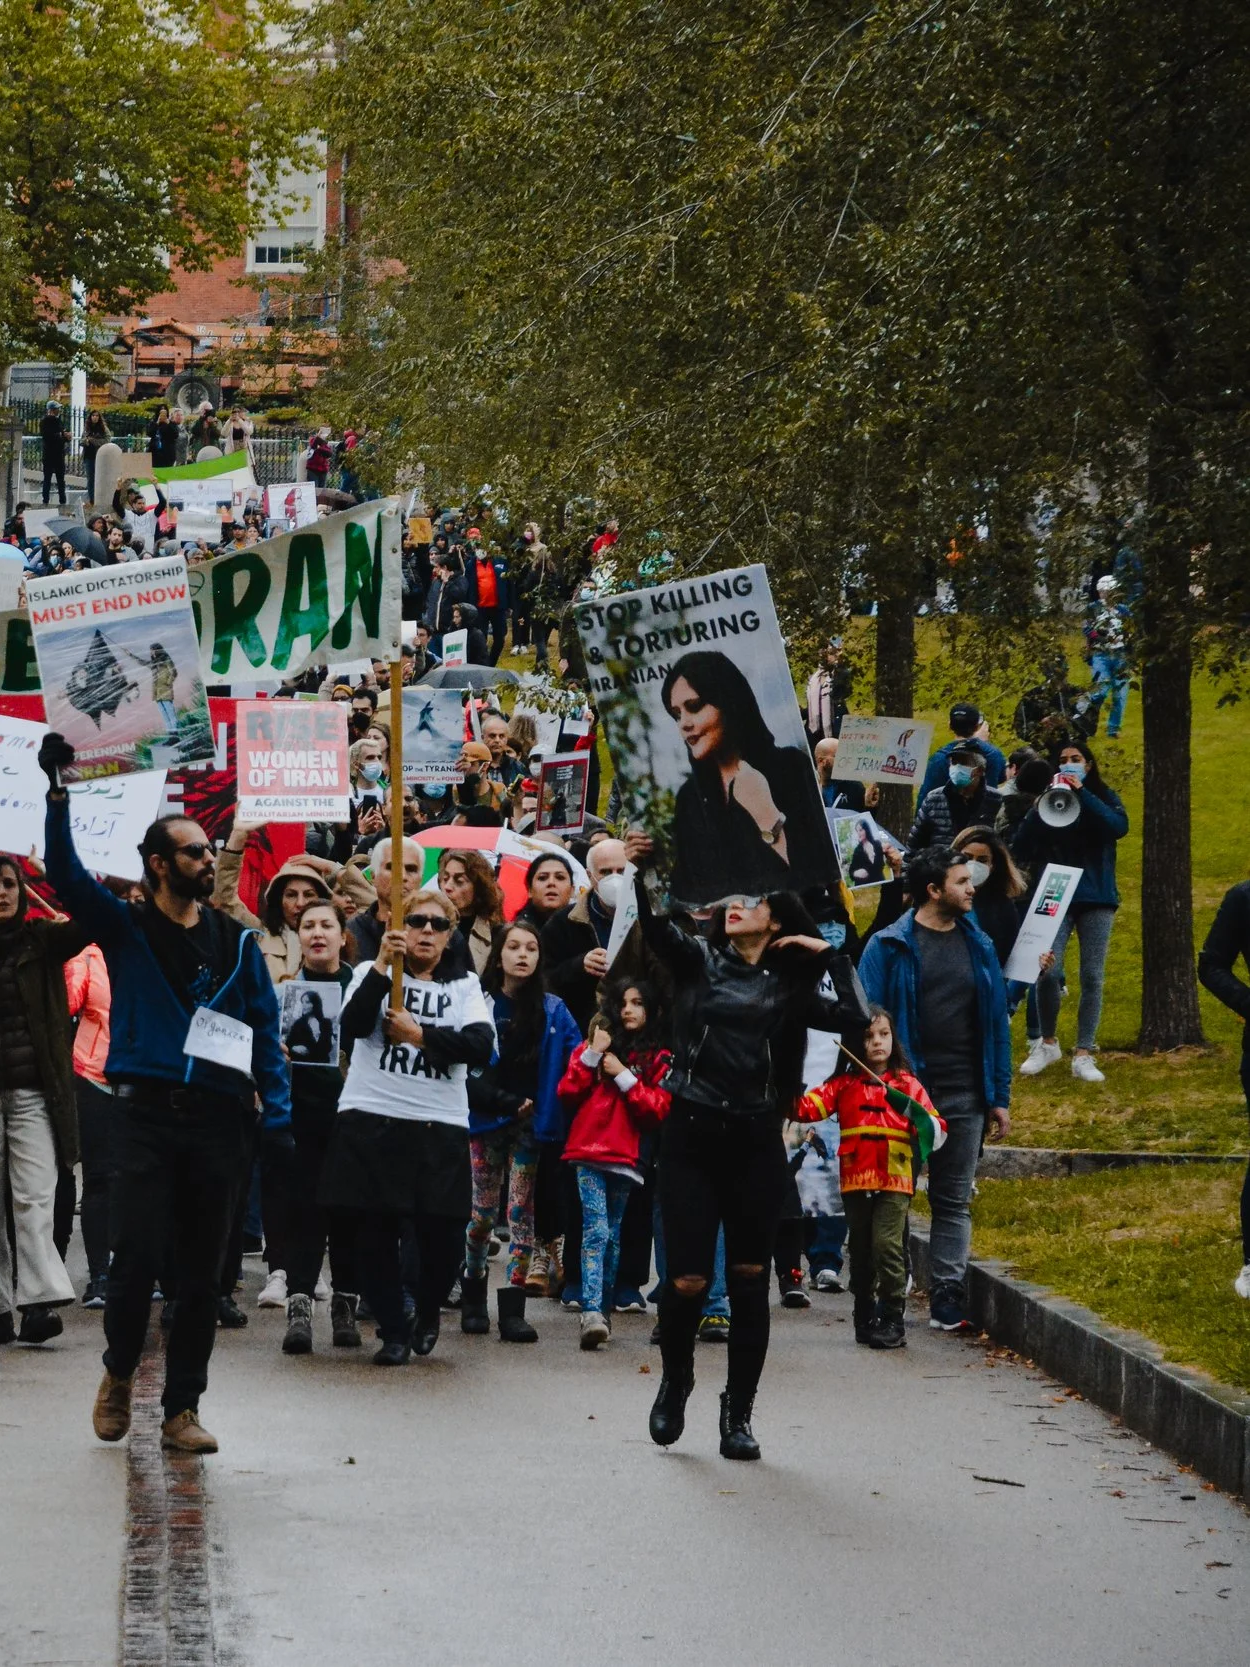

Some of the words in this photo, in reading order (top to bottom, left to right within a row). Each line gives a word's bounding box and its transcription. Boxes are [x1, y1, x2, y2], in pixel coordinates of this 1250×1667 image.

[28, 584, 84, 602] ISLAMIC
[87, 566, 183, 593] DICTATORSHIP
[32, 601, 87, 625] MUST
[92, 594, 133, 614] END
[138, 584, 186, 606] NOW
[579, 598, 643, 631] STOP
[651, 574, 753, 615] KILLING
[589, 646, 604, 665] &
[610, 610, 760, 660] TORTURING
[246, 710, 339, 741] RISE
[248, 750, 338, 769] WOMEN
[854, 757, 882, 771] IRAN
[248, 769, 278, 787] OF
[283, 769, 339, 787] IRAN
[254, 798, 308, 807] AGAINST
[313, 798, 335, 807] THE
